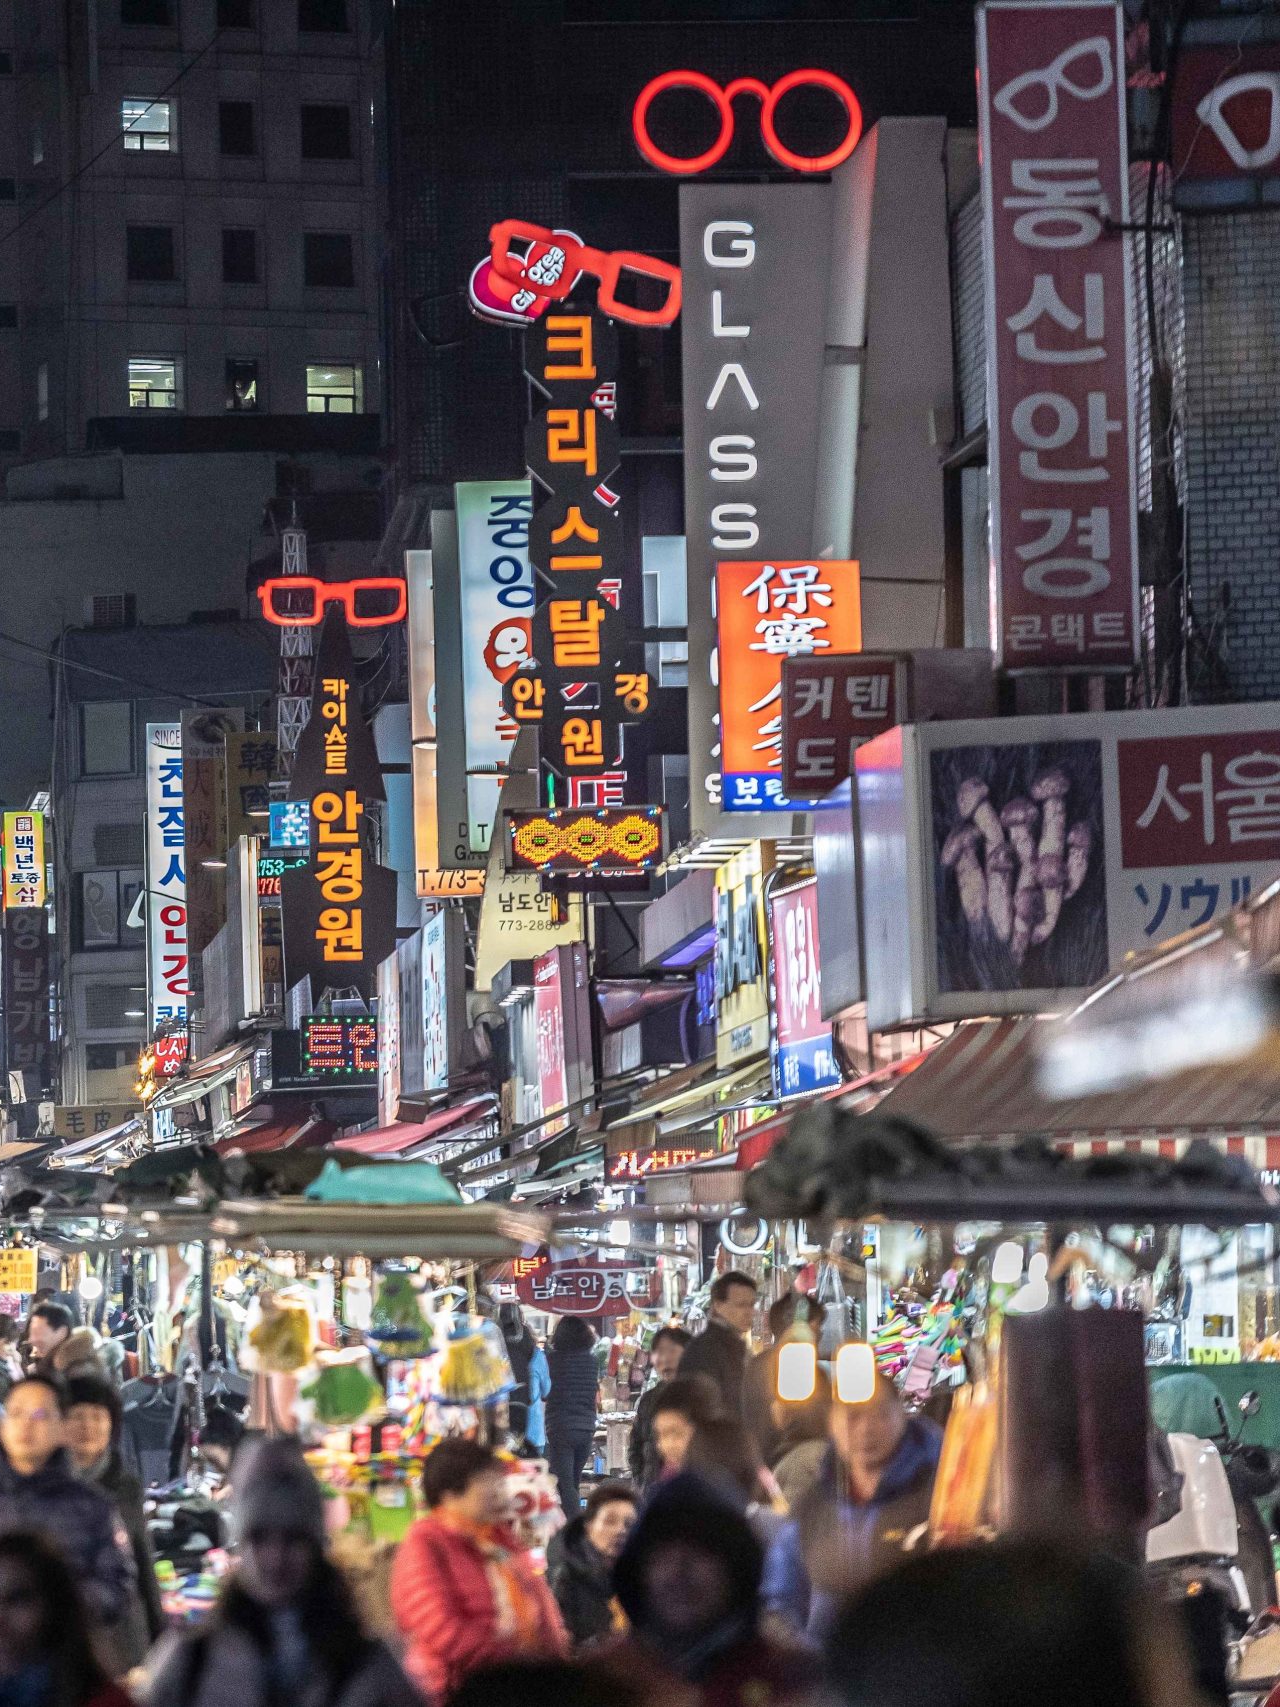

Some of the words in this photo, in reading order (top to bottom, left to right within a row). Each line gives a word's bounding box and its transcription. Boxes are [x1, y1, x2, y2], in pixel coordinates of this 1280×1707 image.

[703, 220, 760, 550] GLASS
[1003, 159, 1122, 599] 동신안경
[544, 315, 605, 667] 크리스탈
[1006, 612, 1130, 653] 콘택트
[794, 674, 890, 719] 커텐
[154, 729, 181, 746] SINCE
[1135, 750, 1280, 845] 서울
[257, 858, 308, 877] 753-
[311, 790, 364, 962] 안경원
[498, 892, 551, 913] 남도안
